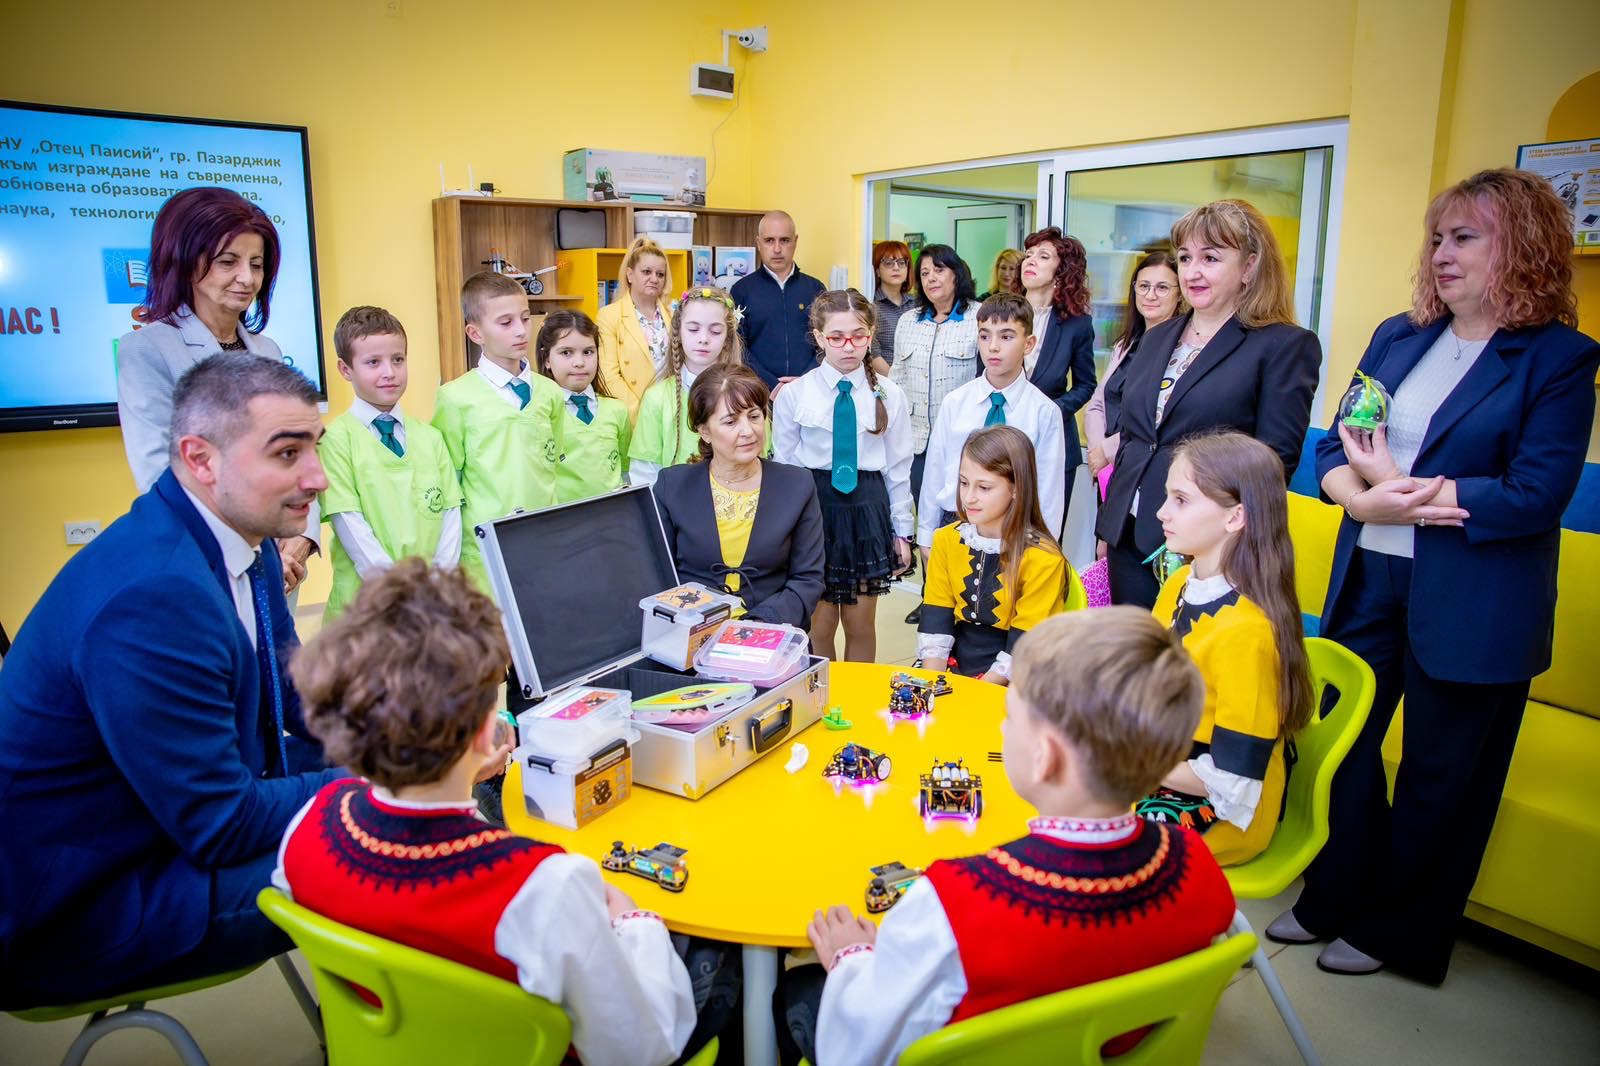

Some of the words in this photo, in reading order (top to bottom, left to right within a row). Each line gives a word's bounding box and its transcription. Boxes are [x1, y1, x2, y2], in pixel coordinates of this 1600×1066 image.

[170, 151, 190, 165] гр.
[197, 151, 281, 168] Пазарджик
[0, 160, 38, 171] към
[48, 162, 151, 178] изграждане
[160, 169, 179, 180] на
[187, 170, 283, 186] съвременна,
[0, 176, 86, 193] обновена
[0, 203, 55, 219] наука,
[0, 306, 43, 334] АС
